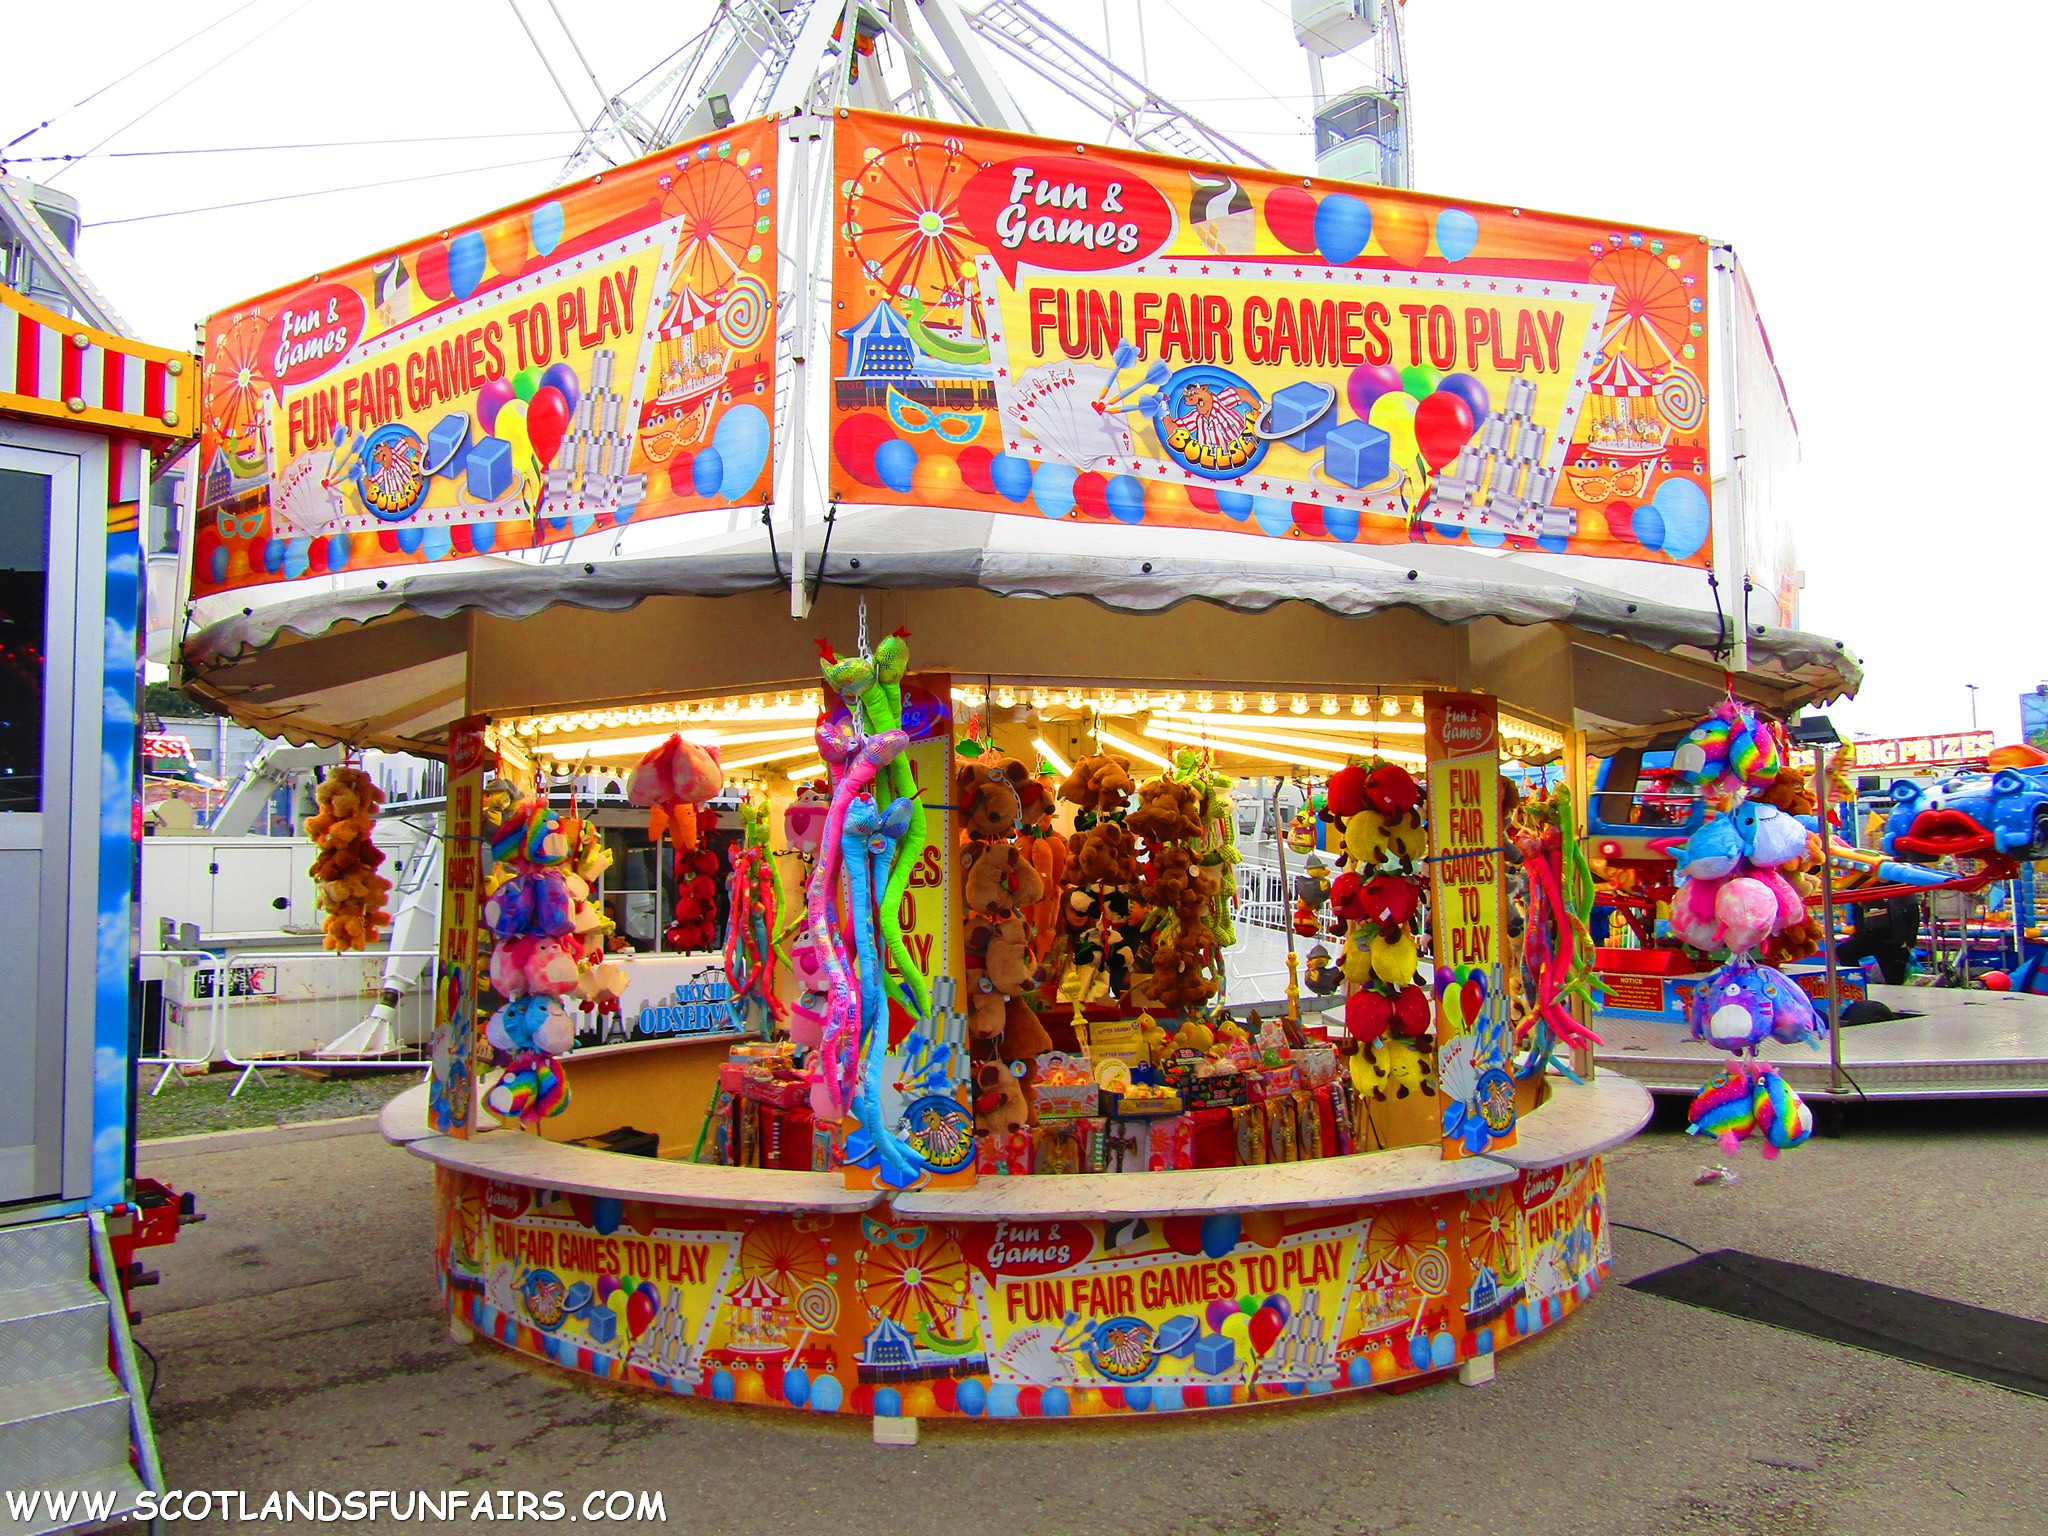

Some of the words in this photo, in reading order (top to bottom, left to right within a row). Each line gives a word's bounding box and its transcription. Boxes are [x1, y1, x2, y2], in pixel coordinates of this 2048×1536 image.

[1009, 166, 1088, 210] Fun
[1101, 182, 1124, 213] &
[995, 203, 1139, 253] Games
[281, 310, 320, 343] Fun
[327, 296, 339, 321] &
[1029, 287, 1121, 358] FUN
[1134, 292, 1233, 362] FAIR
[1244, 296, 1391, 367] GAMES
[1402, 304, 1456, 371] TO
[1465, 307, 1565, 373] PLAY
[273, 326, 347, 377] Games
[288, 388, 338, 456] FUN
[343, 362, 401, 438] FAIR
[406, 320, 506, 412] GAMES
[508, 301, 553, 371] TO
[557, 265, 638, 358] PLAY
[1442, 722, 1482, 743] Games
[1445, 706, 1468, 722] Fun
[1855, 743, 1899, 767] BIG
[1899, 733, 1995, 763] PRIZES
[1449, 769, 1481, 806] FUN
[1449, 808, 1485, 846] FAIR
[1441, 847, 1494, 886] GAMES
[1458, 886, 1480, 925] TO
[1451, 925, 1491, 966] PLAY
[676, 984, 705, 1002] SKY
[710, 983, 728, 1000] HI
[1620, 977, 1643, 985] NOTICE
[994, 1220, 1042, 1243] Fun
[1043, 1222, 1062, 1241] &
[1528, 1204, 1554, 1249] FUN
[493, 1221, 517, 1259] FUN
[517, 1228, 554, 1270] FAIR
[558, 1232, 621, 1276] GAMES
[623, 1239, 651, 1280] TO
[654, 1242, 710, 1285] PLAY
[986, 1240, 1071, 1269] Games
[1006, 1280, 1071, 1323] FUN
[1071, 1274, 1135, 1319] FAIR
[1140, 1257, 1237, 1310] GAMES
[1240, 1253, 1278, 1296] TO
[1282, 1240, 1343, 1286] PLAY
